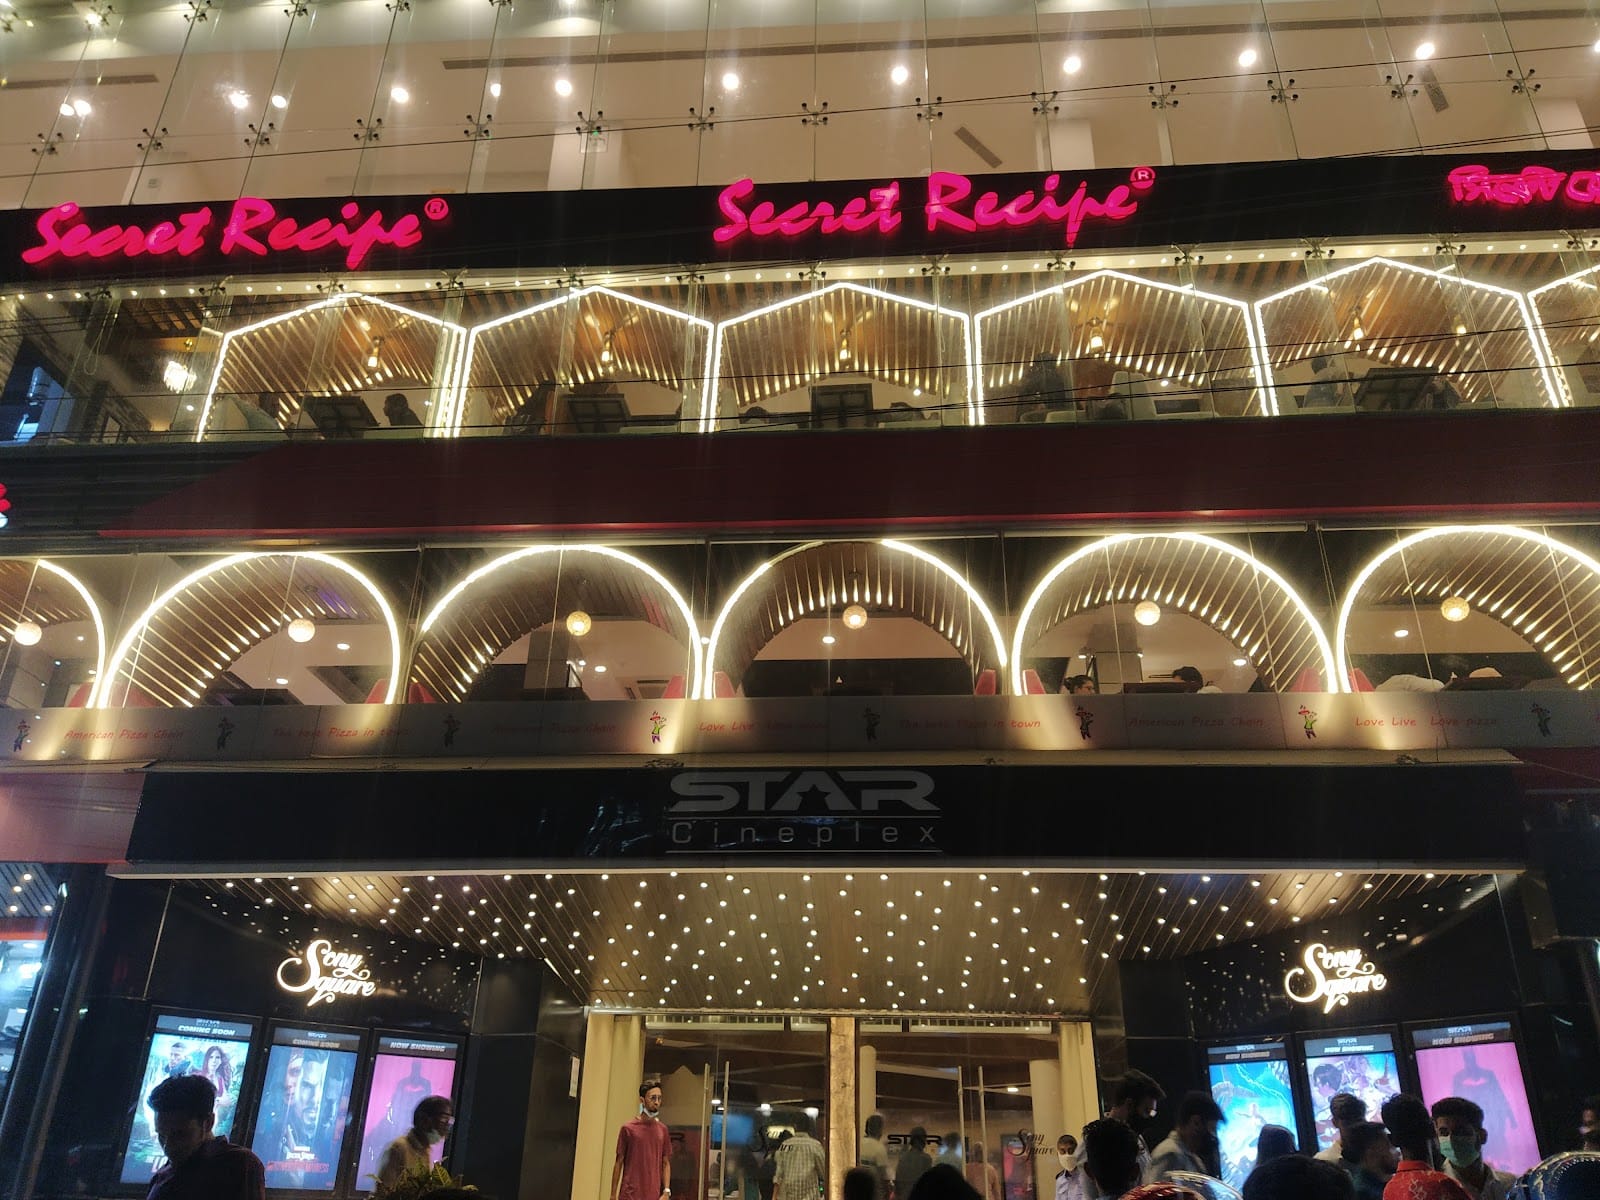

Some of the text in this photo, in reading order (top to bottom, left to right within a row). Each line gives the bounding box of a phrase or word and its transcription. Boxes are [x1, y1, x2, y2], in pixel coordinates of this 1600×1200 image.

[715, 178, 901, 242] Secret
[925, 171, 1137, 247] Recipe
[22, 202, 212, 264] Secret
[221, 197, 423, 270] Recipe
[699, 722, 726, 731] Love
[1010, 720, 1041, 728] town
[1355, 717, 1384, 727] Love
[1391, 717, 1417, 727] Live
[64, 729, 115, 740] American
[119, 728, 148, 740] Pizza
[328, 727, 358, 738] Pizza
[363, 728, 375, 737] in
[668, 770, 942, 812] STAR
[671, 821, 936, 848] Cineplex
[178, 1025, 211, 1034] COMING
[211, 1028, 236, 1036] SOON
[389, 1041, 409, 1050] NOW
[1431, 1037, 1453, 1046] NOW
